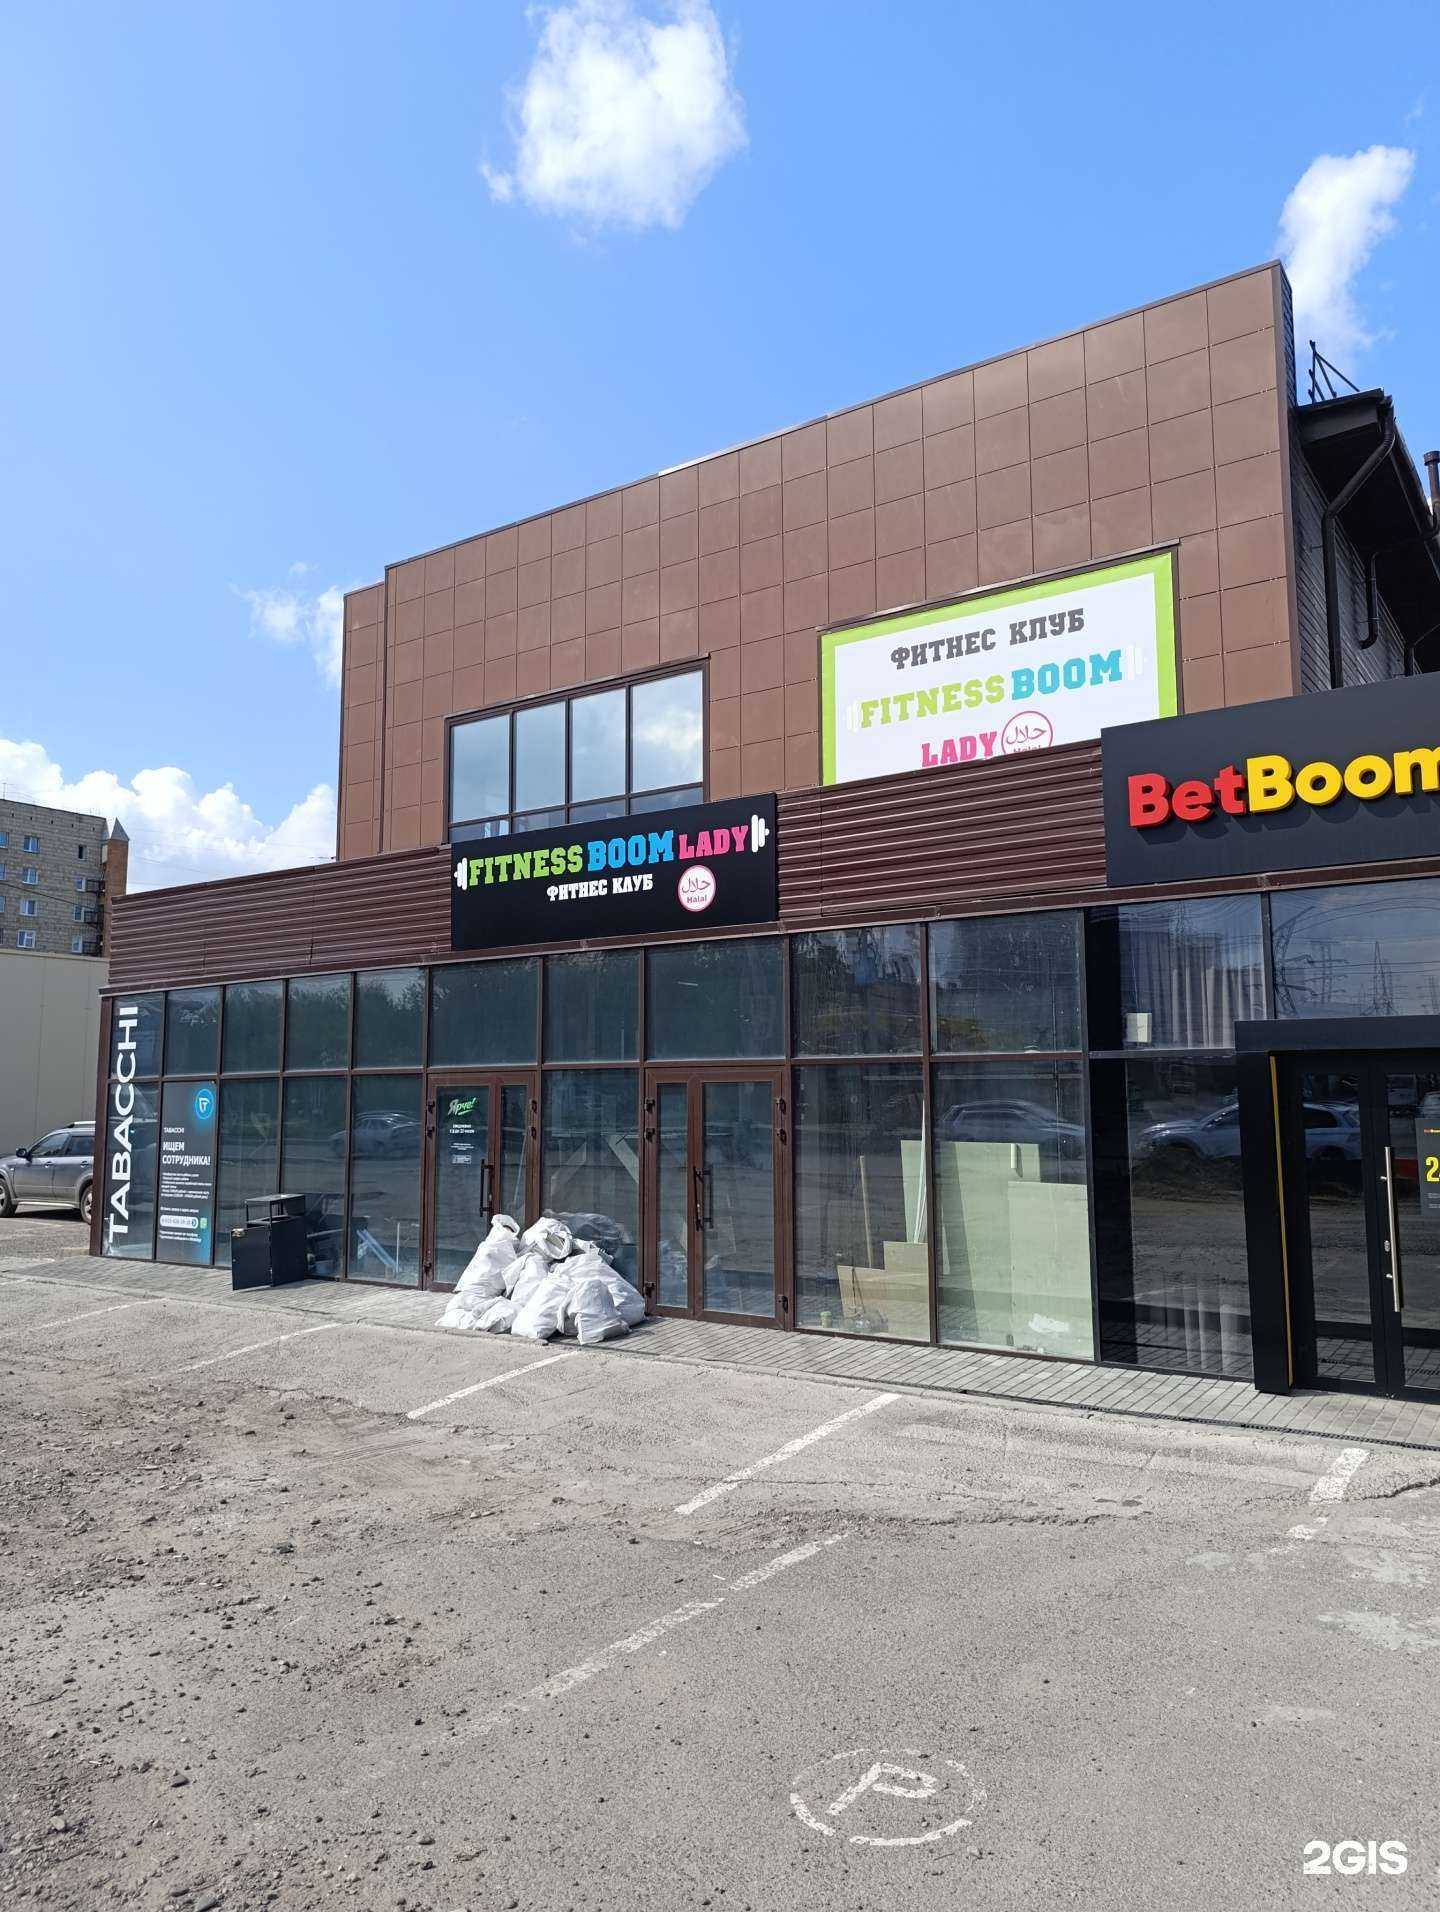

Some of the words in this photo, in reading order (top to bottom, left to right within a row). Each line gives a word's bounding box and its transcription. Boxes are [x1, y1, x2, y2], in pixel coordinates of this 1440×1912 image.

[890, 628, 996, 670] ФИТНЕС
[1009, 608, 1085, 646] КЛУБ
[921, 731, 998, 767] LADY
[678, 825, 750, 860] LADY
[546, 878, 608, 902] ФИТНЕС
[612, 873, 654, 894] КЛУБ
[686, 894, 708, 904] Halal
[108, 1006, 139, 1244] TABACCHI
[162, 1141, 185, 1153] ИЩЕМ
[162, 1154, 211, 1167] СОТРУДНИКА!
